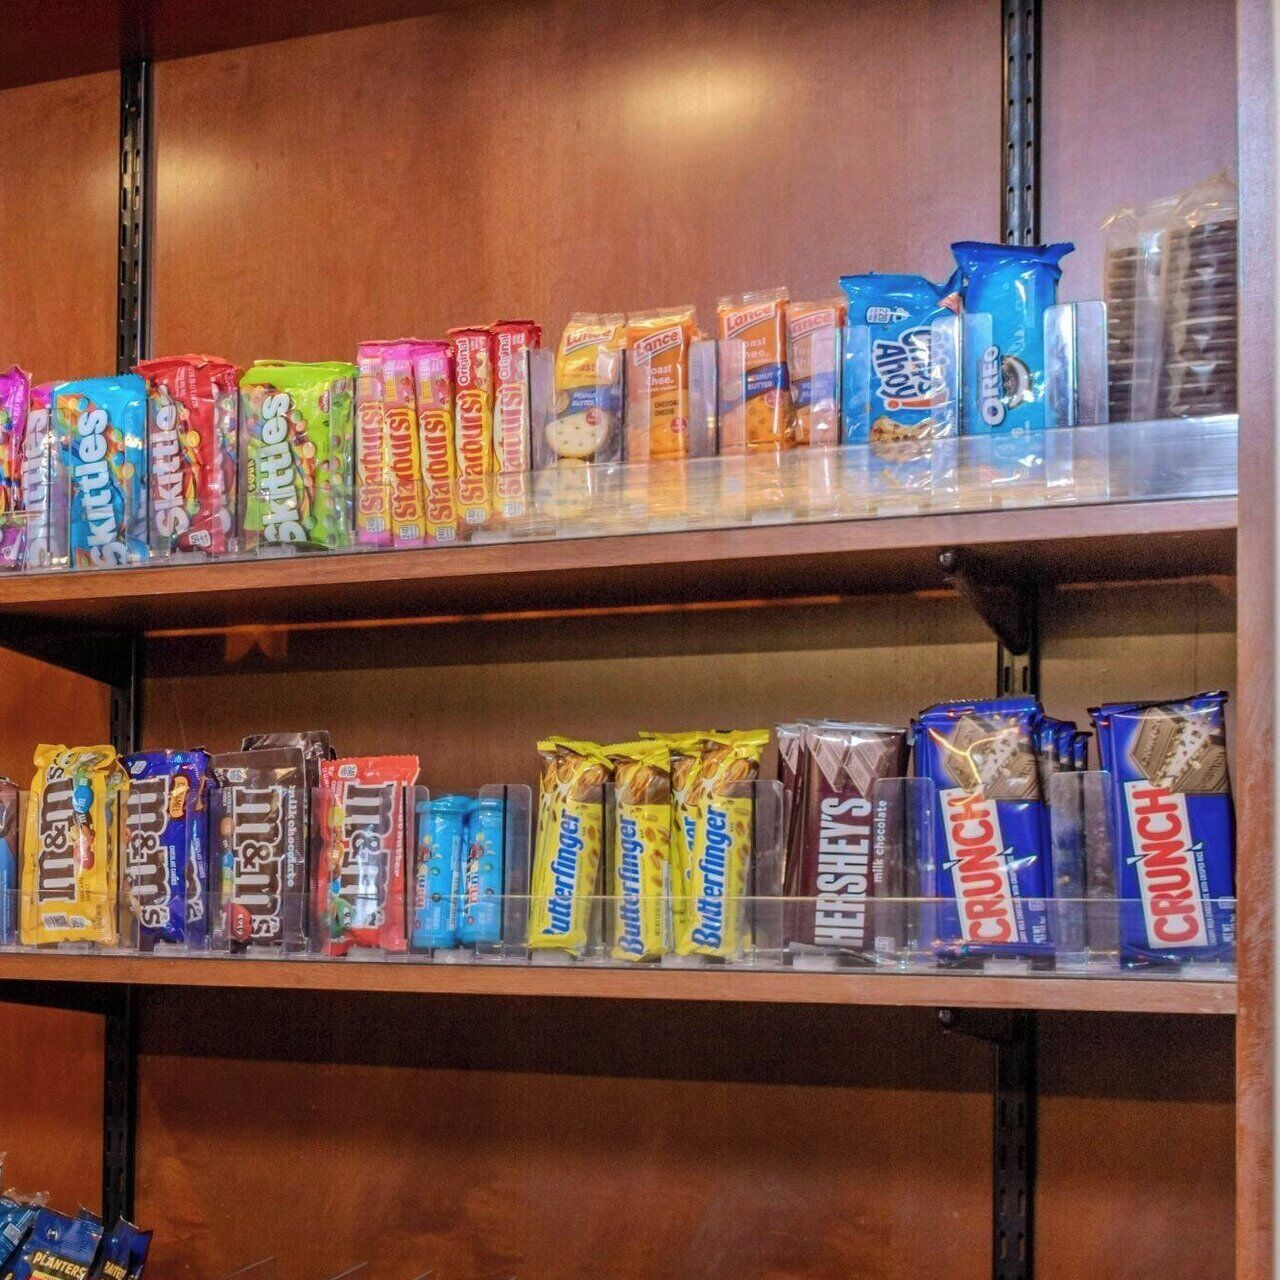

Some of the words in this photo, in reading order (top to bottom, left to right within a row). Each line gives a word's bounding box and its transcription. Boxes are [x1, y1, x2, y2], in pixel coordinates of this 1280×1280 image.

[457, 337, 469, 386] Original
[499, 333, 510, 379] Original
[980, 345, 1007, 427] OREO
[76, 409, 128, 568] Skittles
[359, 402, 384, 514] Starburst
[386, 409, 416, 521] Starburst
[420, 411, 453, 523] Starburst
[456, 391, 484, 504] Starburst
[497, 384, 524, 498] Starburst
[691, 802, 734, 950] Butterfinger
[813, 797, 871, 949] HERSHEY'S
[873, 852, 883, 883] milk
[874, 800, 887, 848] chocolate
[947, 791, 1012, 943] CRUNCH
[1131, 786, 1200, 943] CRUNCH
[616, 814, 644, 957] Butterfinger
[32, 1251, 88, 1279] PLANTERS
